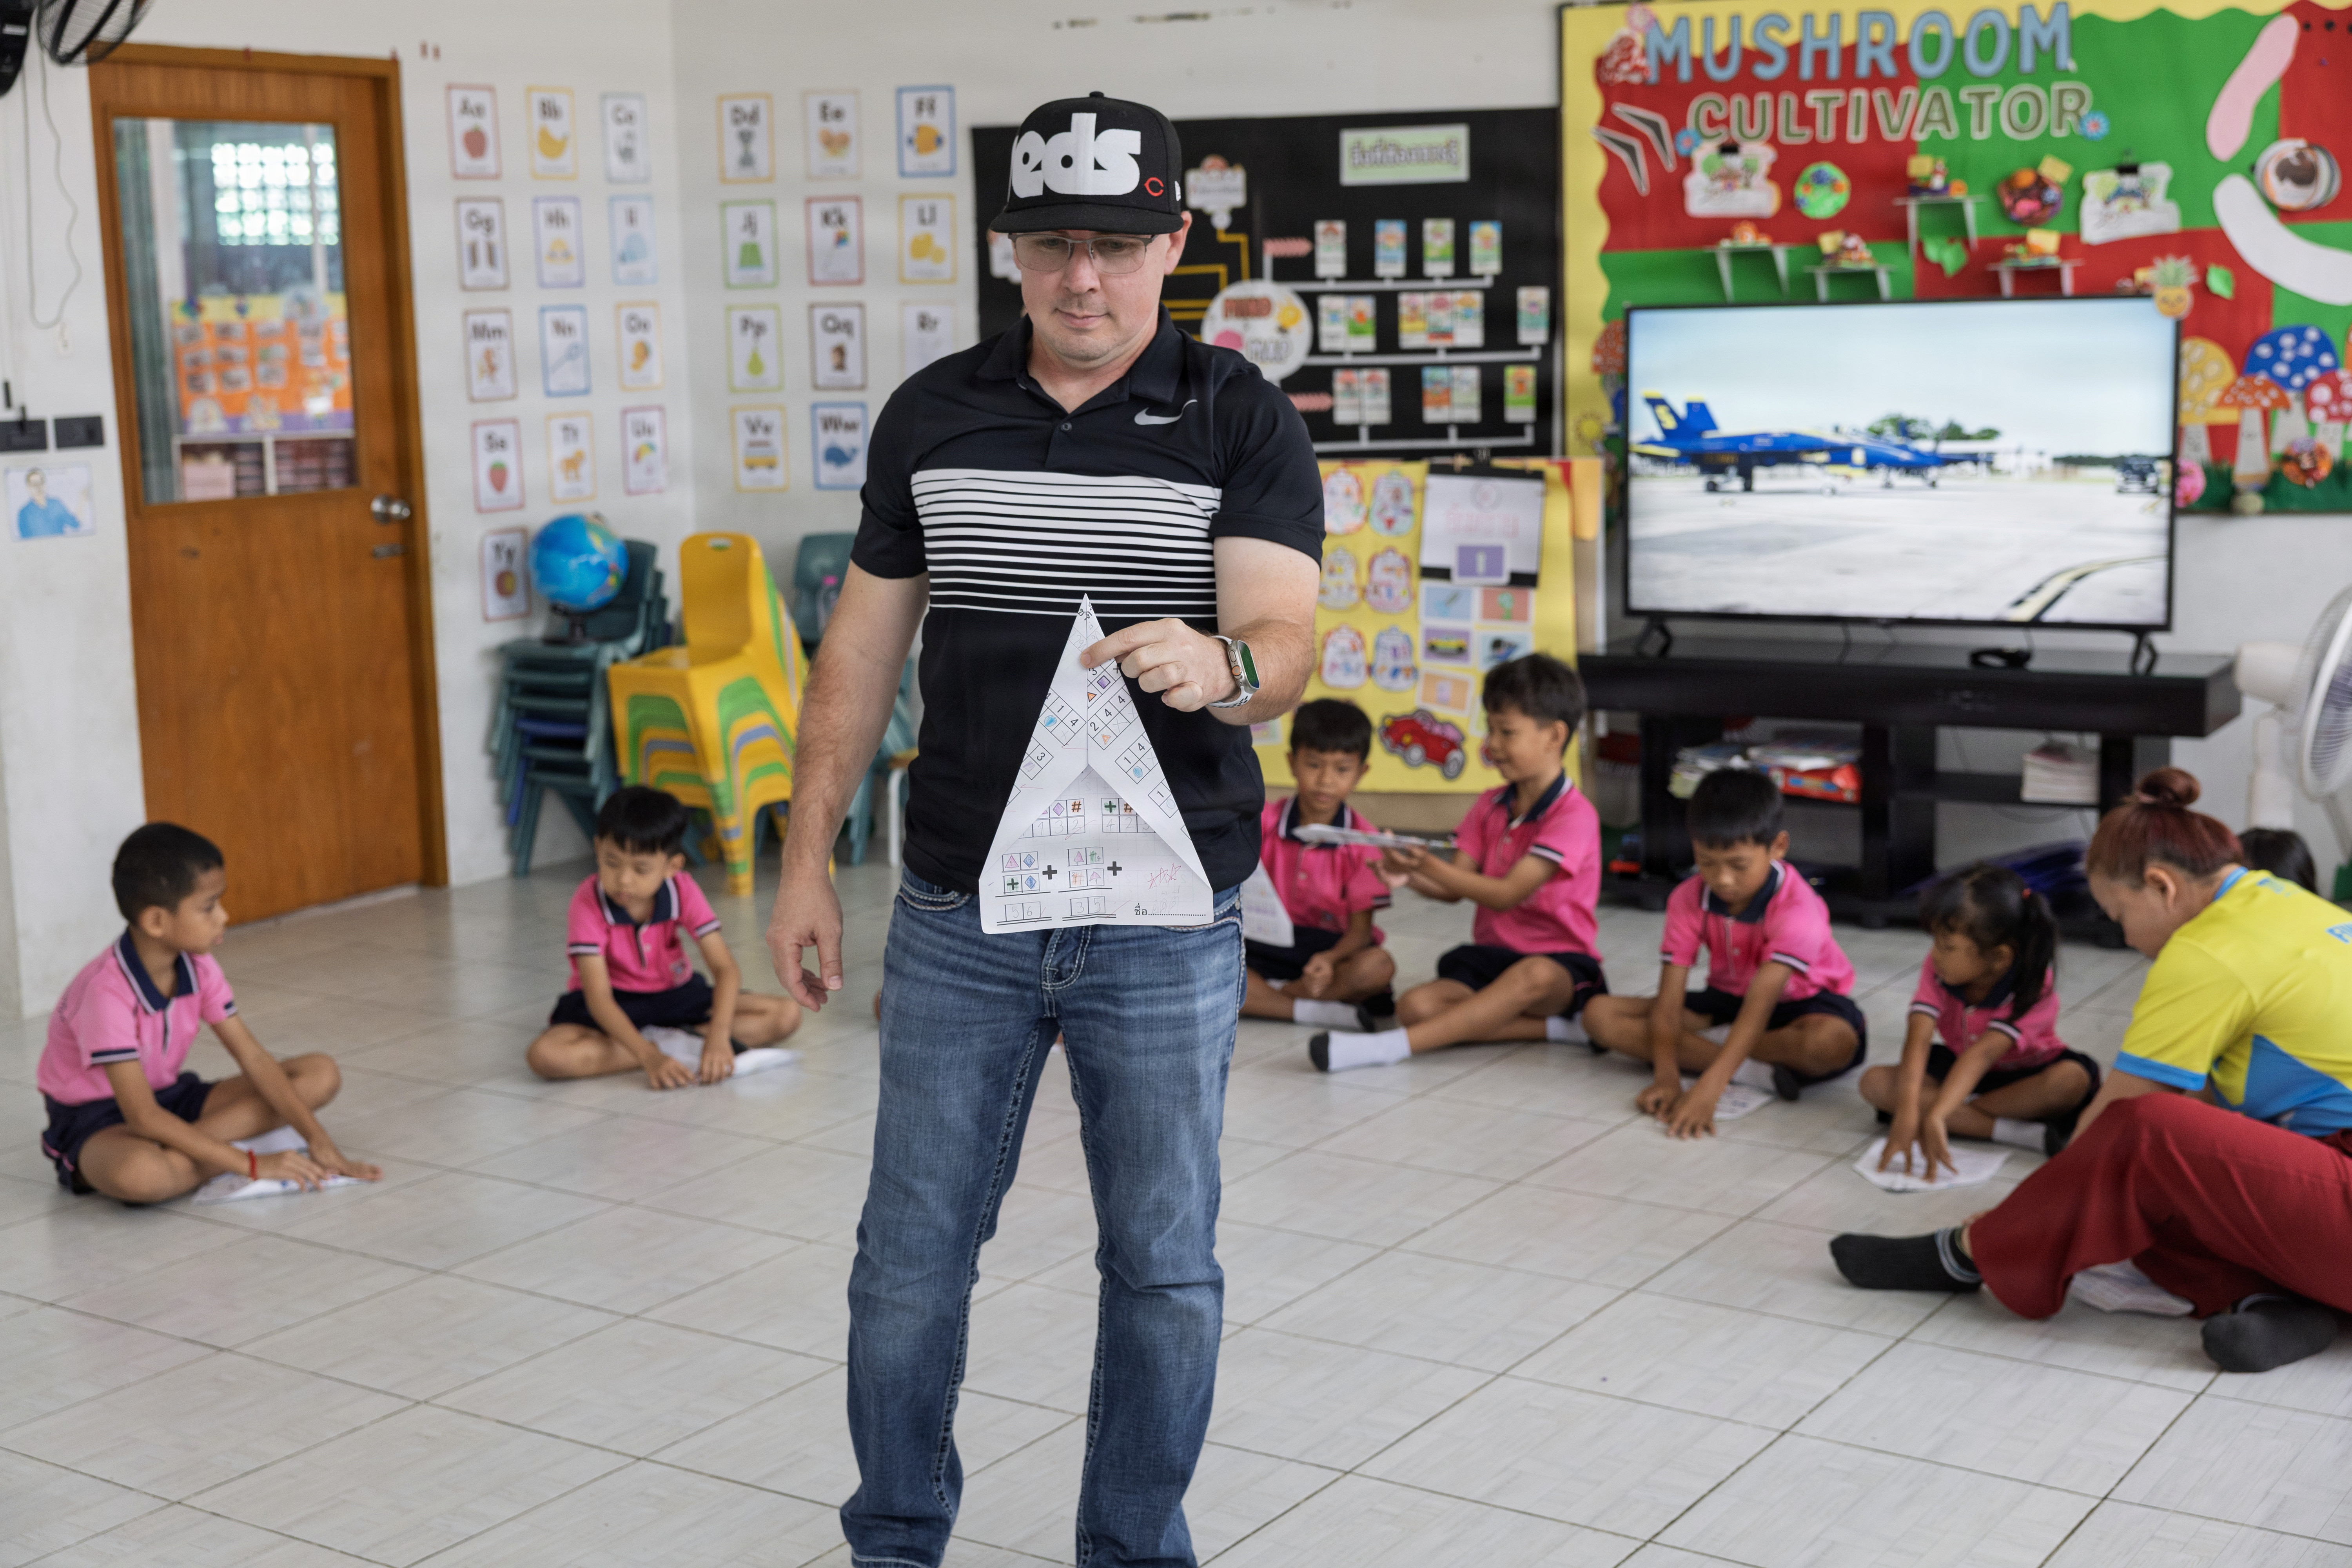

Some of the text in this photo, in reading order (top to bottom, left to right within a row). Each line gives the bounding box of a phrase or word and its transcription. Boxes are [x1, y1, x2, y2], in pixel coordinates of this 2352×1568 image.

[1644, 1, 2071, 85] MUSHROOM
[1687, 81, 2092, 143] CULTIVATOR
[1007, 113, 1141, 202] eds
[1090, 695, 1125, 731] 2 4 4
[1138, 742, 1145, 751] 4
[1037, 752, 1045, 761] 3
[1055, 820, 1063, 834] 3
[1072, 819, 1081, 830] 2
[1106, 819, 1115, 831] 4
[1125, 817, 1134, 829] 2
[1012, 906, 1032, 918] 5 6
[1076, 897, 1101, 913] 3 5
